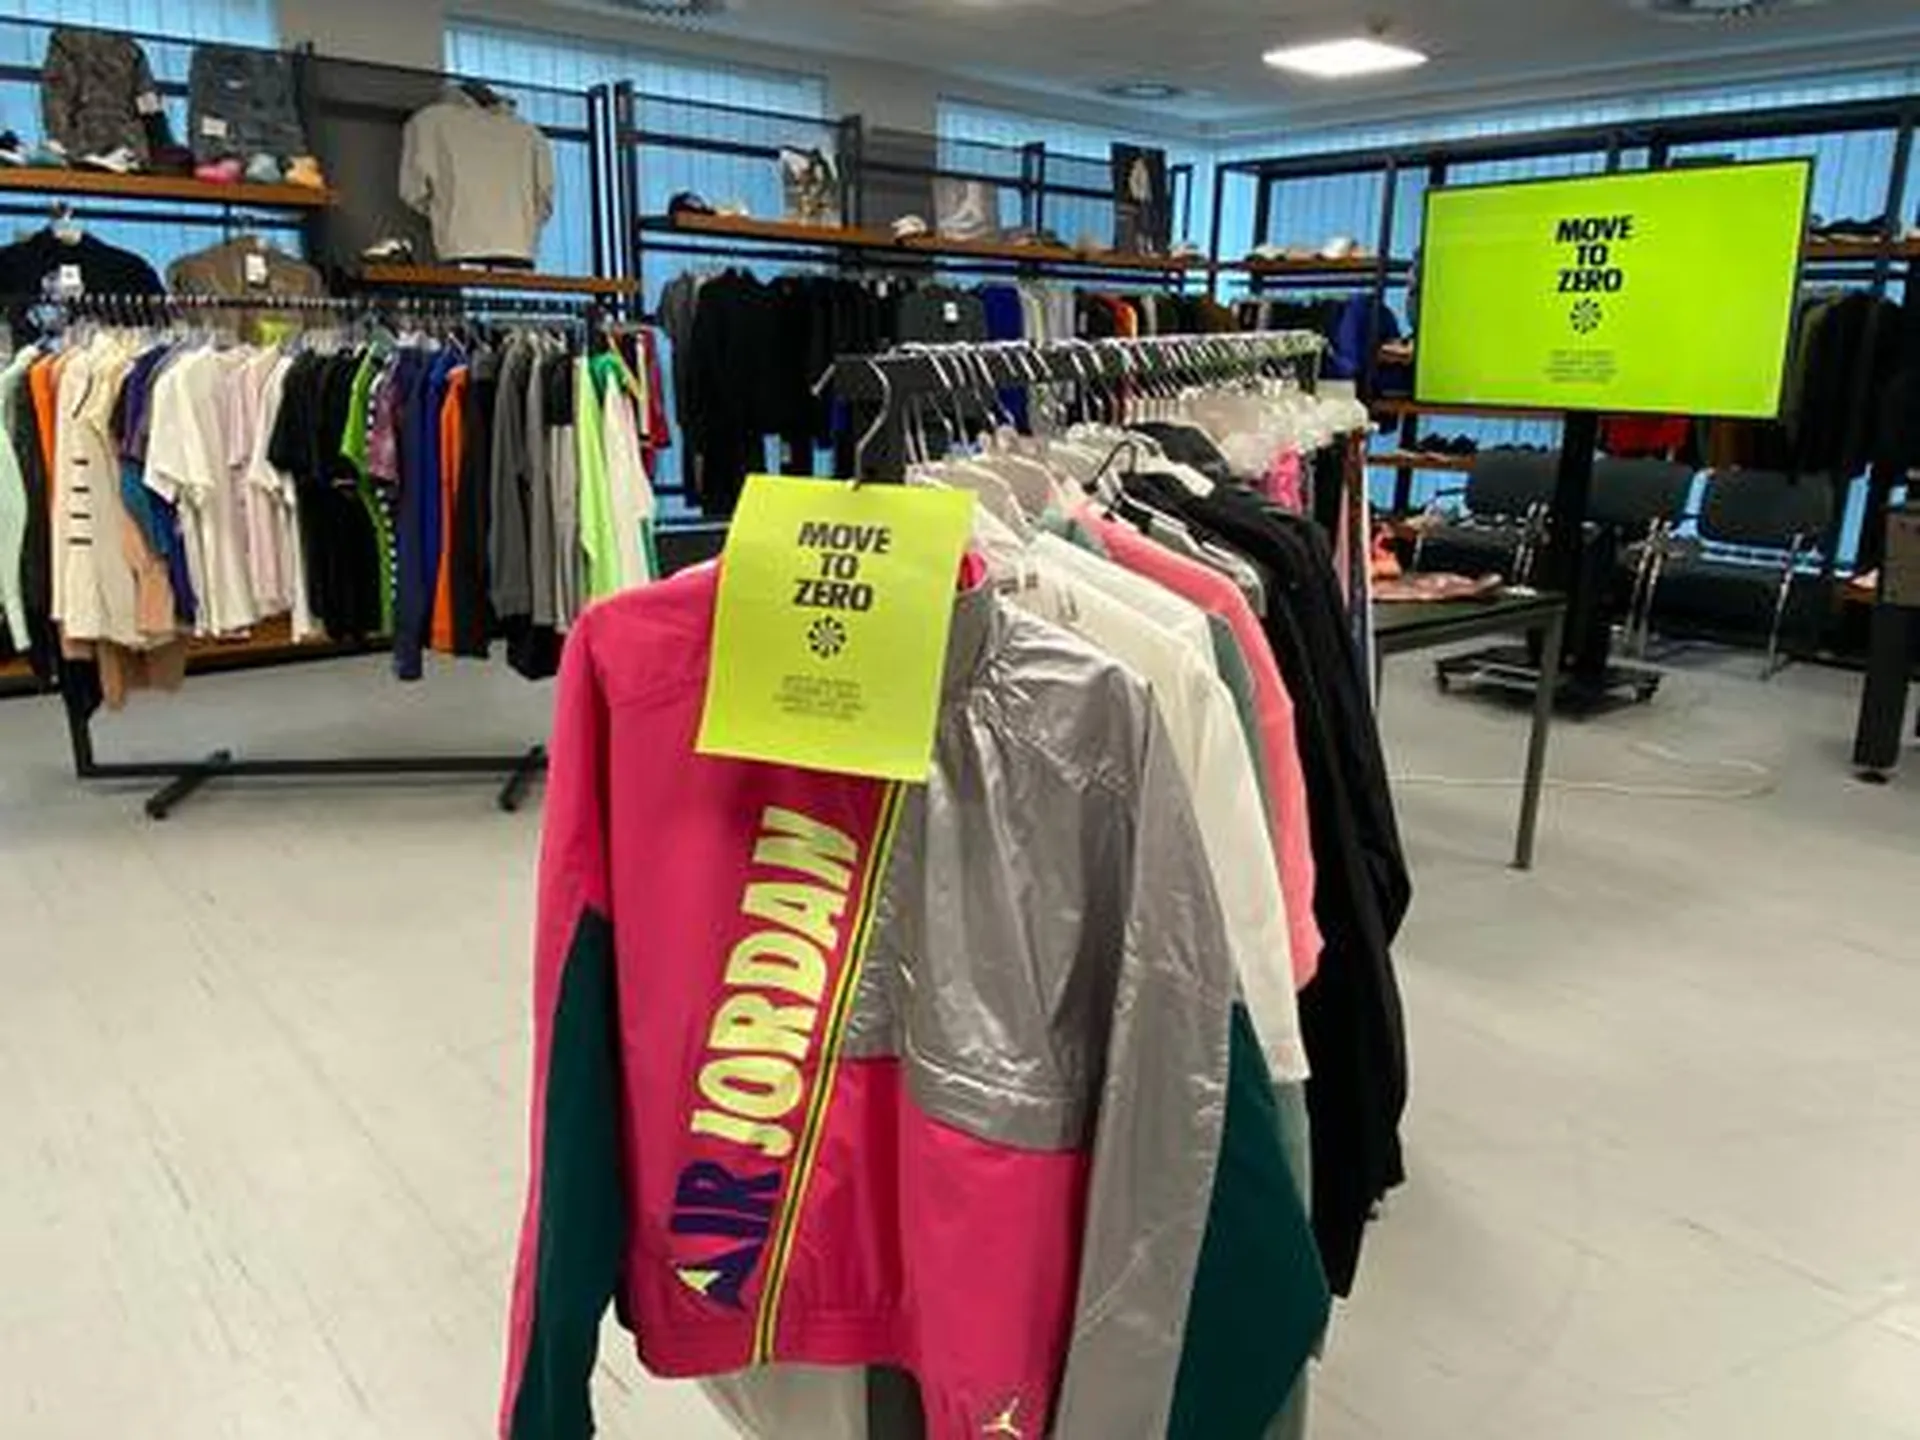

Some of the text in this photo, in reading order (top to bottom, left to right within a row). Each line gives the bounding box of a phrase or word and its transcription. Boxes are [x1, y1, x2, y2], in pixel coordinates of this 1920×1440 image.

[1556, 214, 1634, 242] MOVE
[1576, 244, 1608, 266] TO
[1557, 268, 1623, 293] ZERO
[797, 521, 892, 553] MOVE
[819, 553, 859, 580] TO
[793, 579, 874, 612] ZERO
[690, 805, 859, 1158] JORDAN
[669, 1159, 782, 1309] AIR
